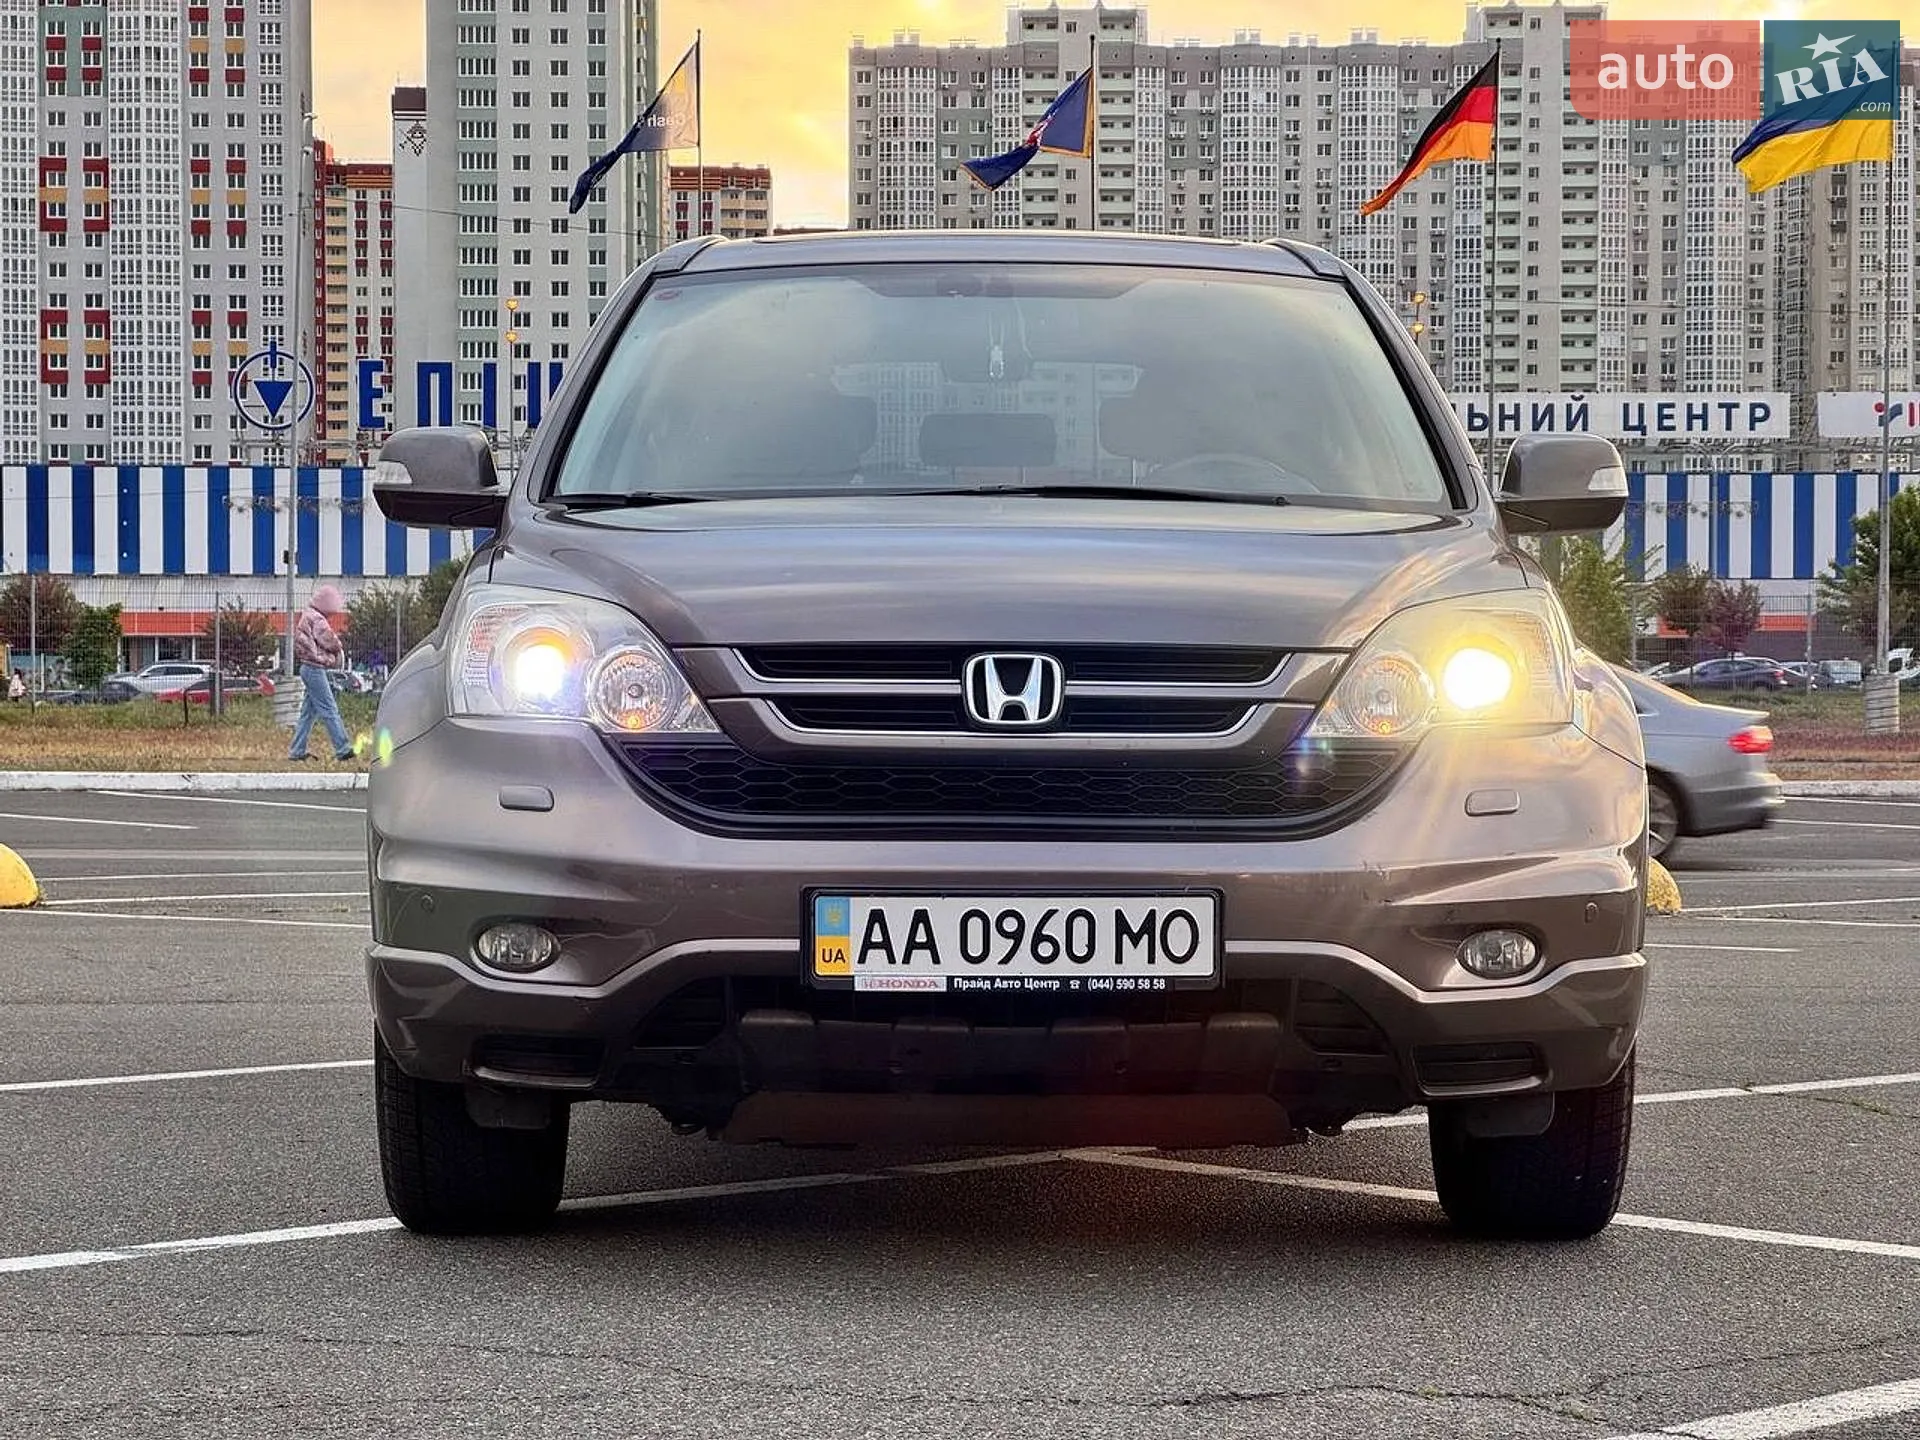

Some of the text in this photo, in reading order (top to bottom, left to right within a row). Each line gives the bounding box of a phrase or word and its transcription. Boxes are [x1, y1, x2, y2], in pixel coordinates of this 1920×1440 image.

[1451, 394, 1771, 436] ЬНИЙ ЦЕНТР
[857, 908, 1200, 966] AA 0960 MO
[821, 947, 847, 964] UA
[878, 979, 939, 989] HONDA
[953, 977, 1166, 990] Прайд Авто Центр (044) 590 58 58
